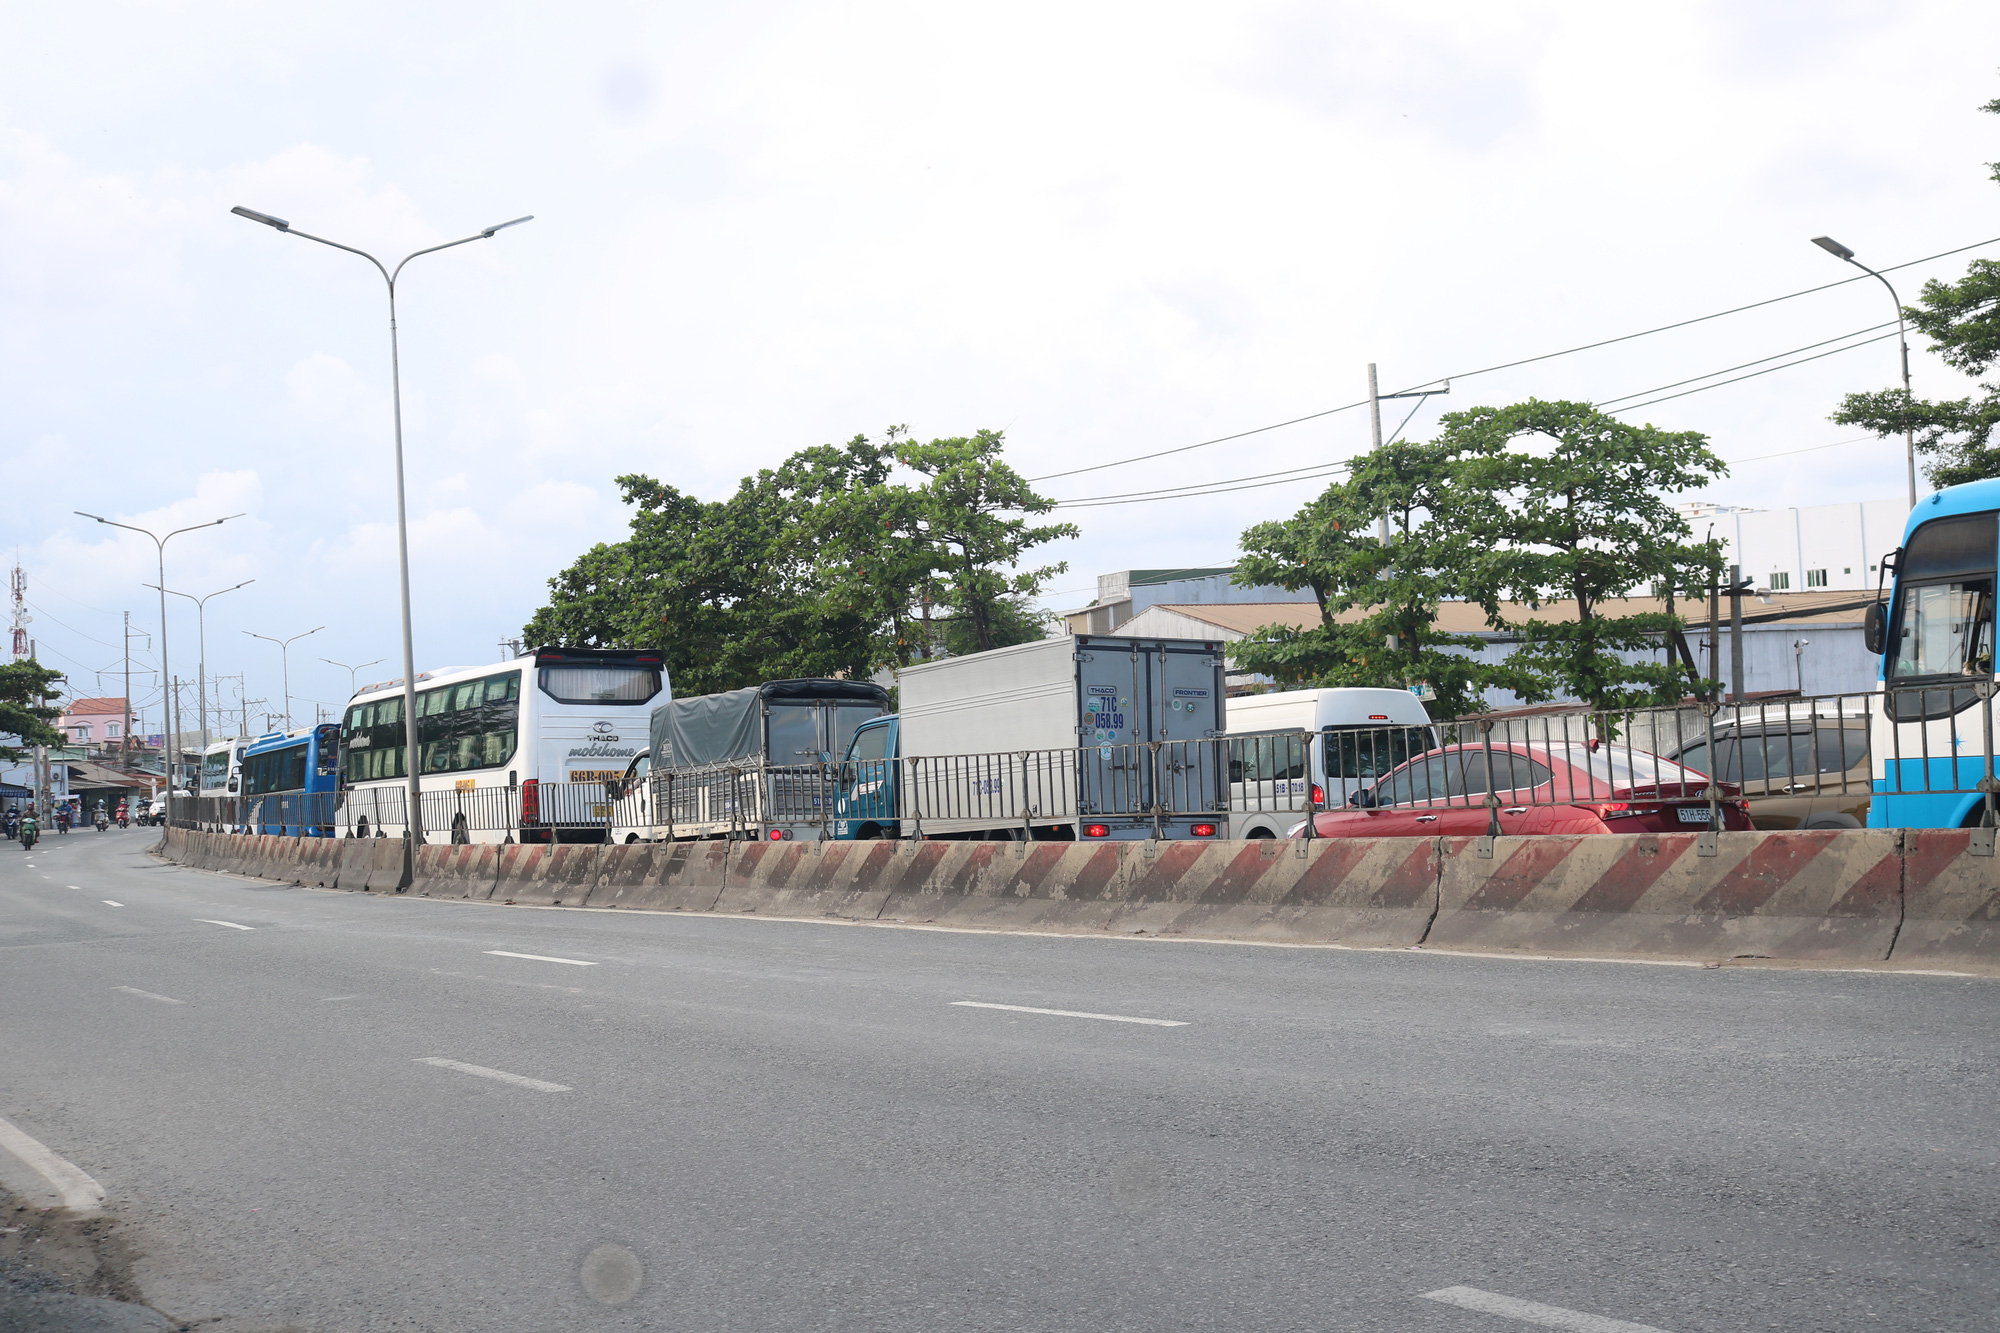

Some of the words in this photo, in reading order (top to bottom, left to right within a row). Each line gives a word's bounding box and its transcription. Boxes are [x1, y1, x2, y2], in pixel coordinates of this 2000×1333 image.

[1101, 696, 1117, 713] 71C
[1095, 713, 1124, 729] 058.99
[568, 742, 637, 757] mobihome
